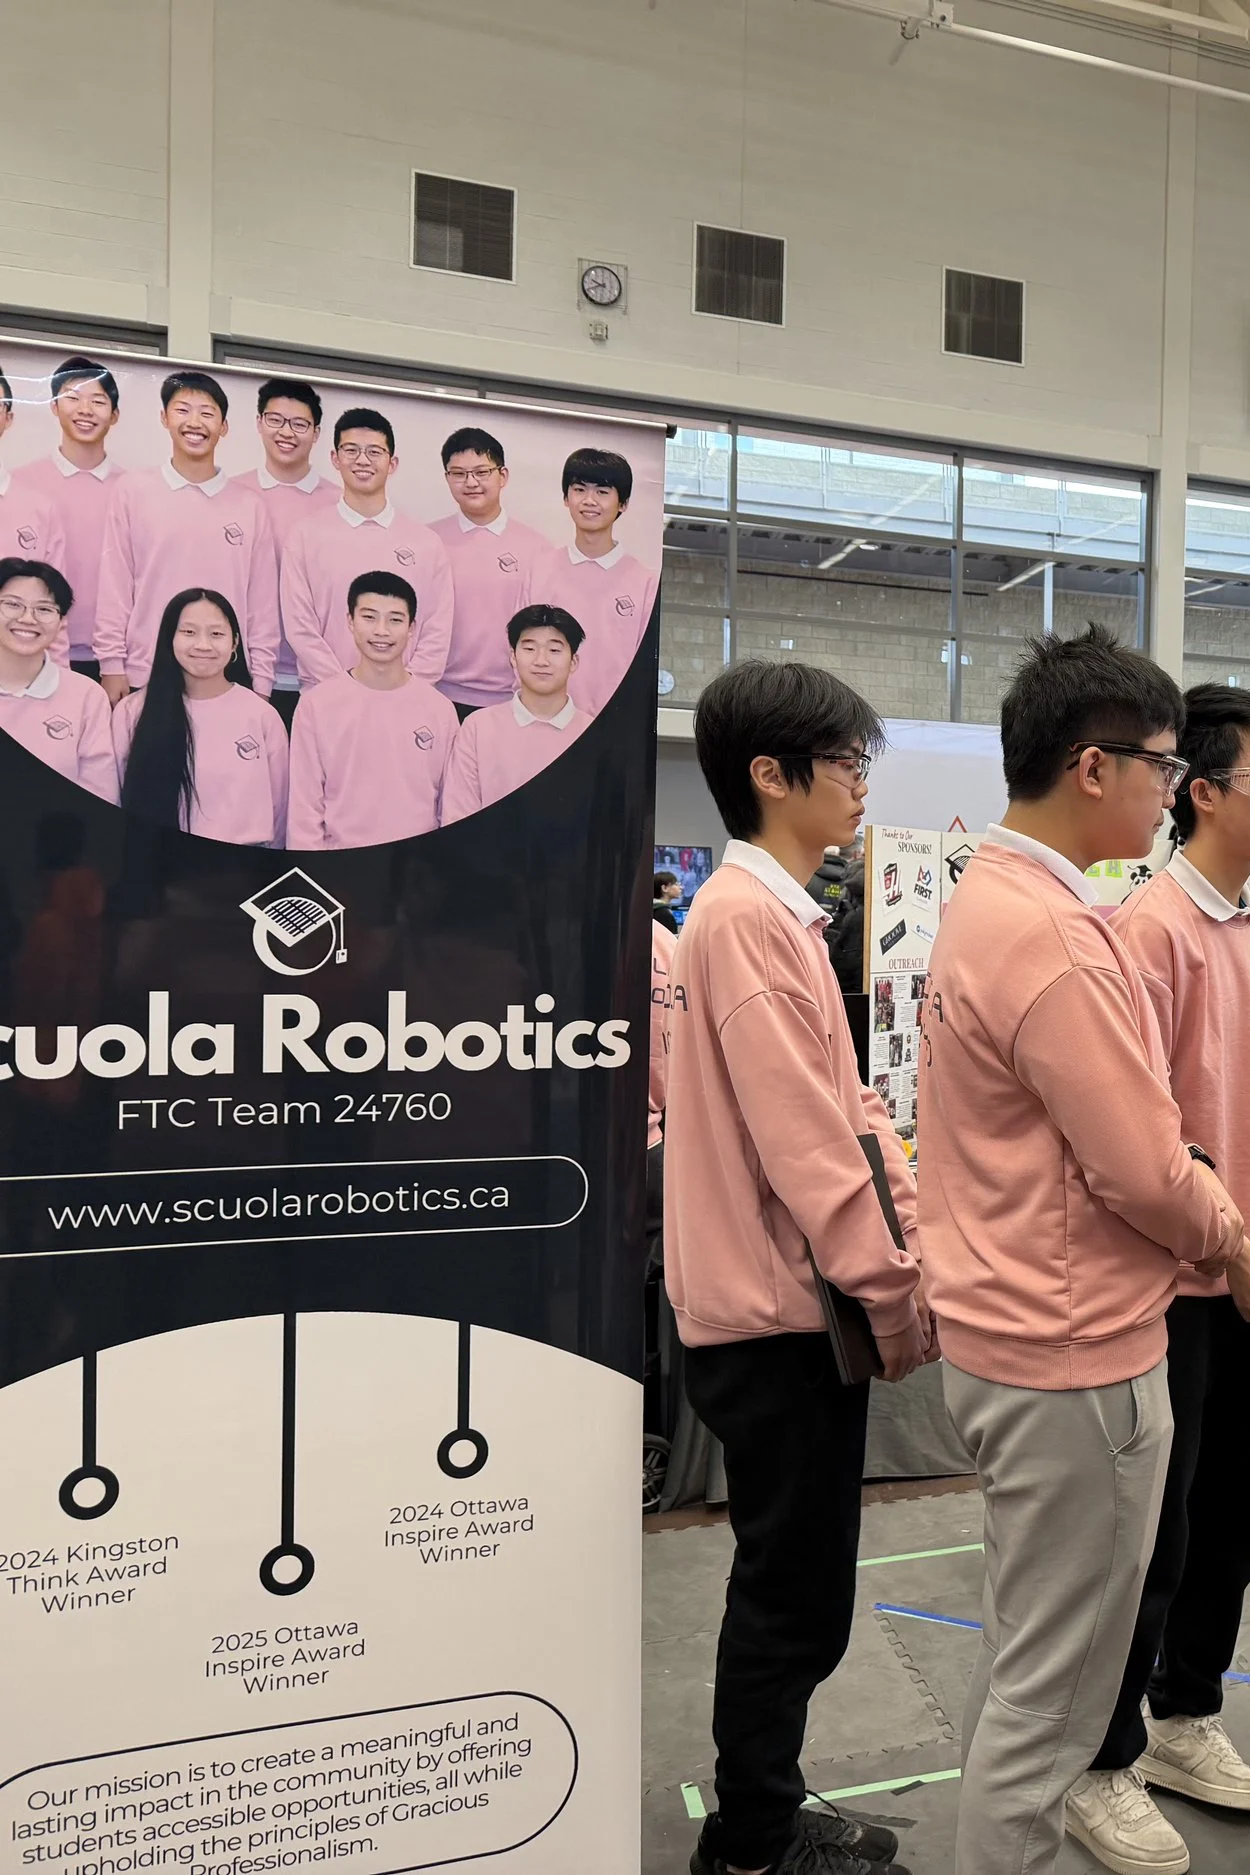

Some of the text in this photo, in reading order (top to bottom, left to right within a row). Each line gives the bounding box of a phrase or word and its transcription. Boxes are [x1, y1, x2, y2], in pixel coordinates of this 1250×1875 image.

[898, 841, 932, 855] SPONSORS!
[914, 883, 932, 900] FIRST
[889, 958, 924, 969] OUTREACH
[263, 990, 631, 1074] Robotics
[119, 1093, 452, 1129] FTC Team 24760
[48, 1183, 509, 1230] www.scuolarobotics.ca
[390, 1497, 529, 1525] 2024 Ottawa
[385, 1514, 534, 1548] Inspire Award
[0, 1536, 179, 1573] 2024 Kingston
[420, 1543, 501, 1565] Winner
[6, 1555, 168, 1595] Think Award
[41, 1587, 136, 1613] Winner
[211, 1621, 359, 1654] 2025 Ottawa
[205, 1639, 365, 1678] Inspire Award
[243, 1670, 330, 1695] Winner
[28, 1712, 519, 1811] Our mission is to create a meaningful and
[12, 1738, 532, 1841] lasting impact in the community by offering
[22, 1760, 523, 1865] students accessible opportunities, all while
[201, 1836, 242, 1856] the
[249, 1815, 361, 1853] principles
[366, 1805, 389, 1827] of
[392, 1791, 490, 1822] Gracious
